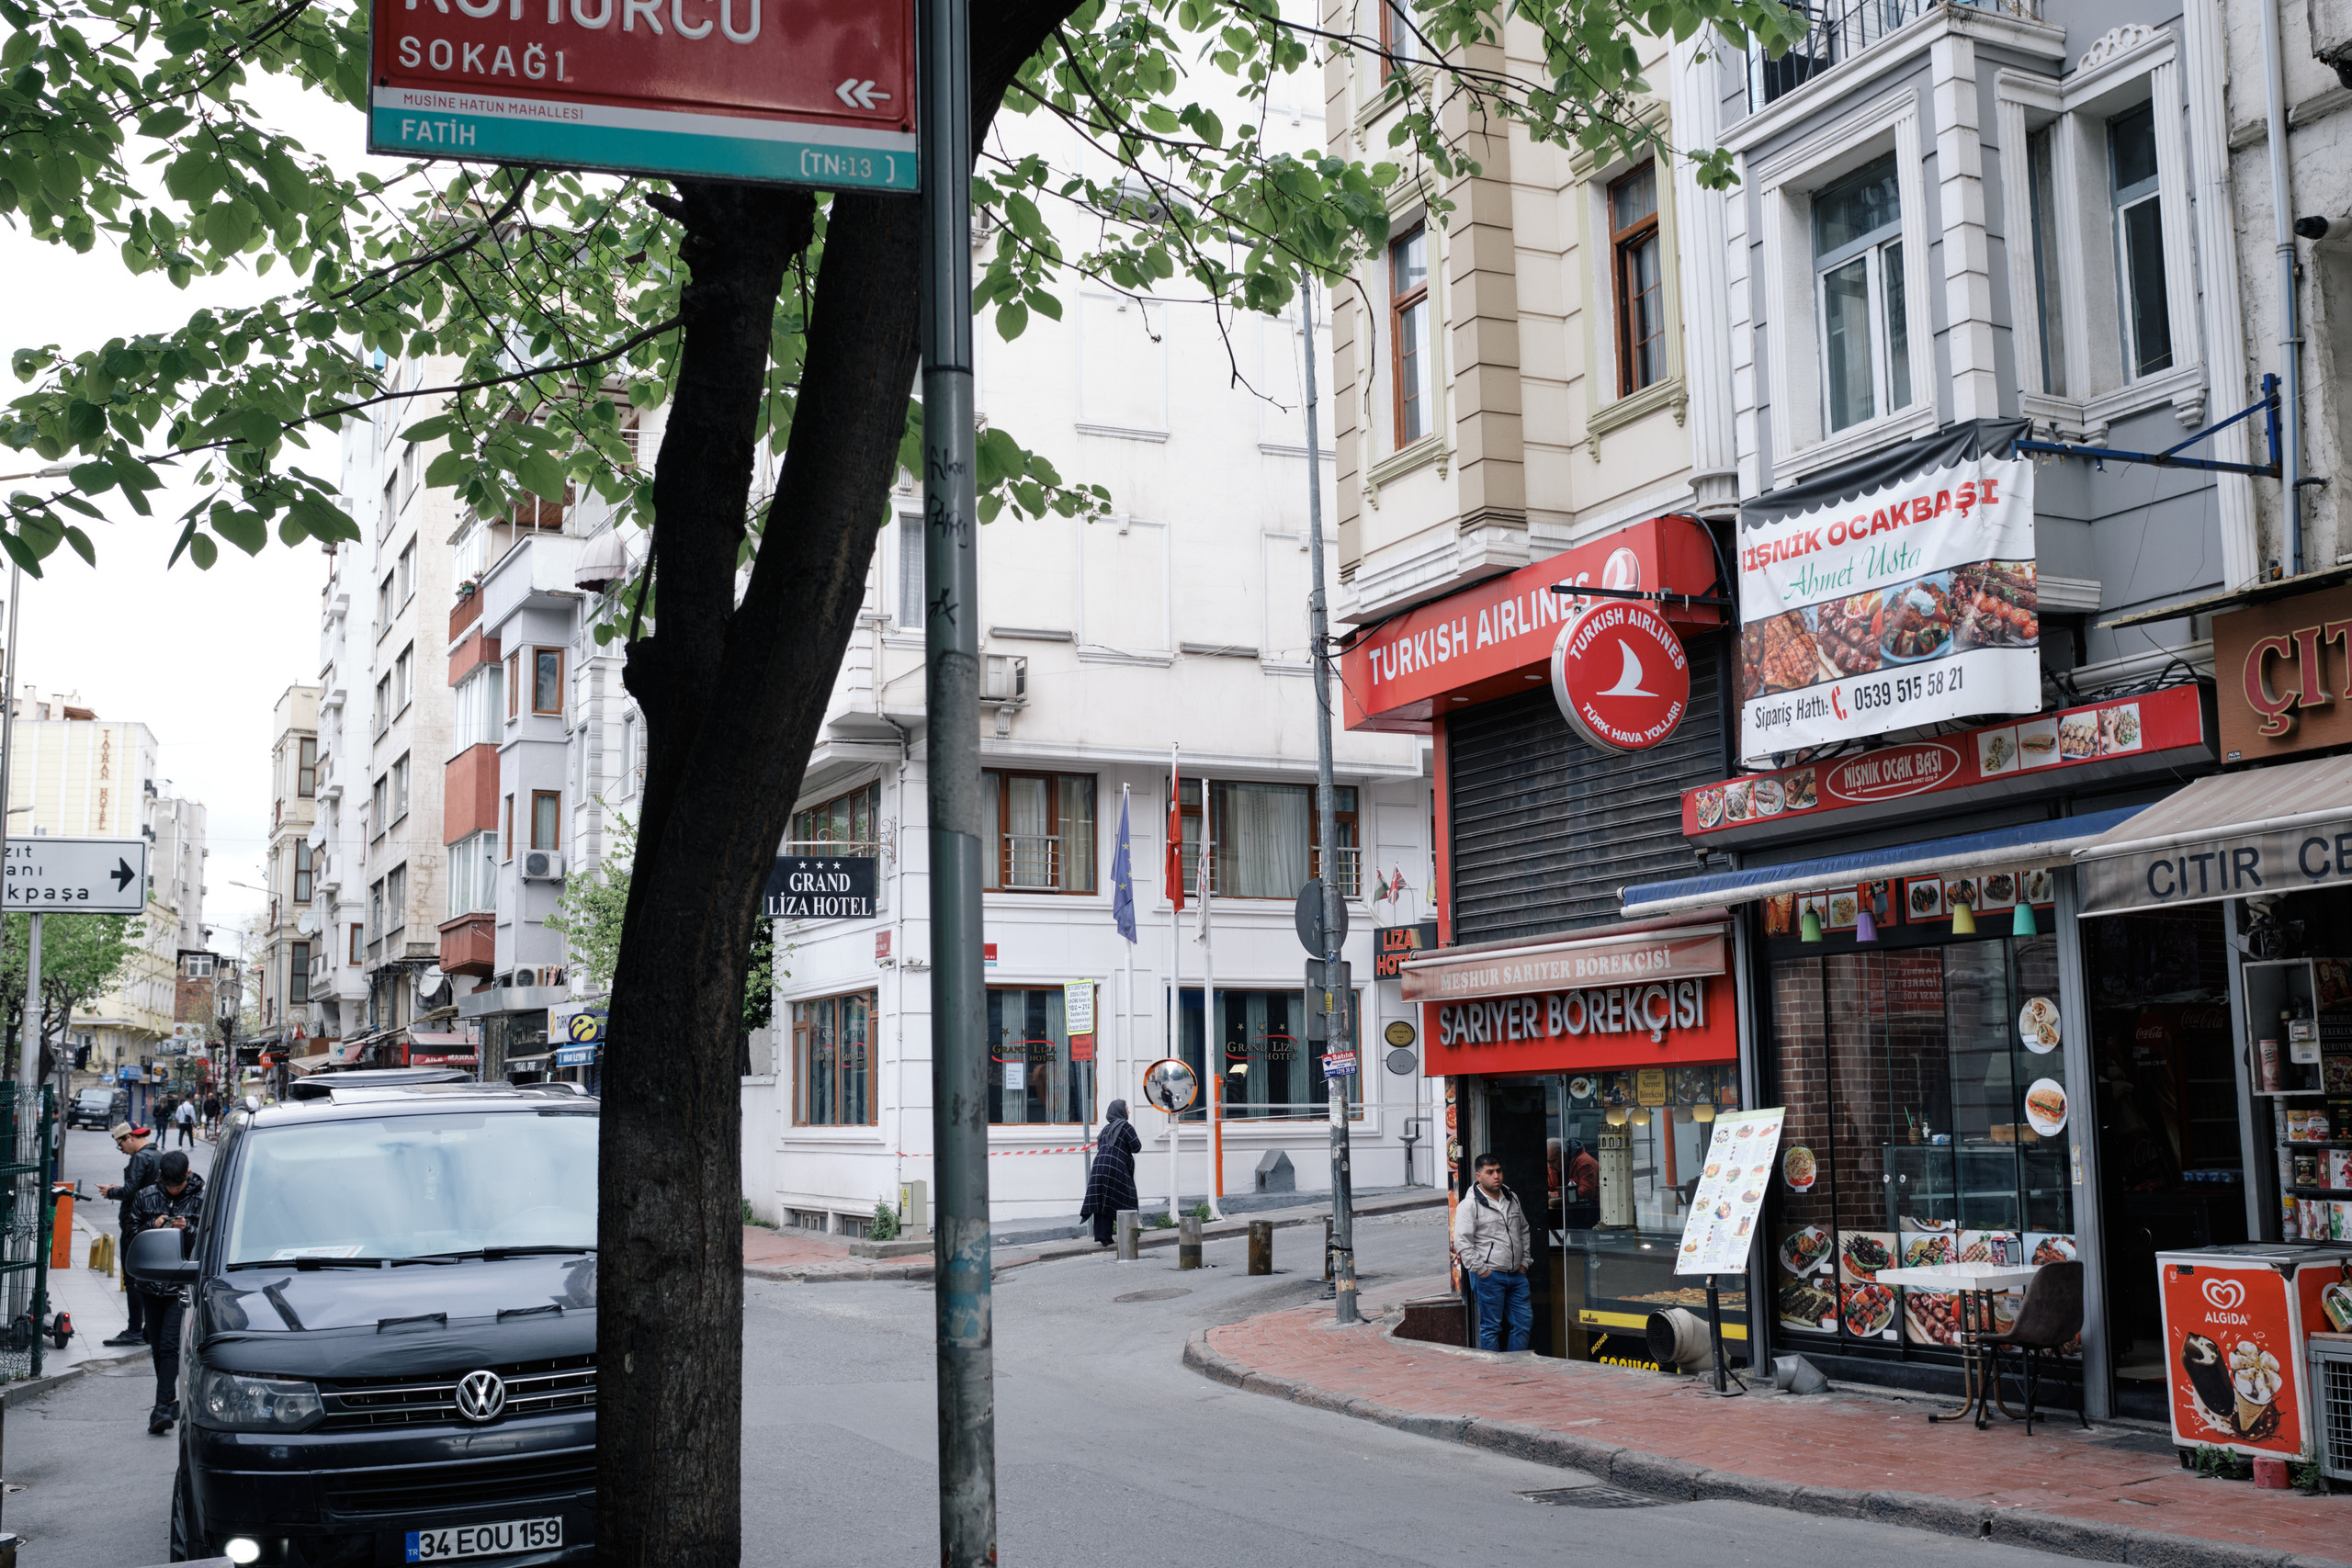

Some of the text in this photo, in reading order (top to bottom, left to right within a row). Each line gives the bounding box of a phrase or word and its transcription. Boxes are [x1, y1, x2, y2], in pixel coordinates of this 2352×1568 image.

[399, 35, 564, 82] SOKAĞI
[403, 94, 583, 120] MUSİNE HATUN MAHALLESİ
[401, 118, 476, 146] FATİH
[1827, 479, 1999, 547] OCAKBAŞI
[1783, 541, 1922, 601] Ahmet Usta
[1368, 570, 1592, 686] TURKISH AIRLINES
[1569, 607, 1685, 671] TURKISH AIRLINES
[1755, 701, 1792, 731] Sipariş
[1854, 682, 1892, 711] 0539
[1896, 675, 1922, 703] 515
[1928, 671, 1944, 696] 58
[1949, 665, 1963, 691] 21
[1582, 701, 1682, 742] TÜRK HAVA YOLLARI
[1883, 754, 1914, 782] OCAK
[98, 787, 108, 830] HOTEL
[789, 872, 852, 892] GRAND
[768, 891, 872, 916] LİZA HOTEL
[1376, 953, 1411, 976] HOT
[1440, 944, 1671, 993] MEŞHUR SARIYER BÖREKÇİSİ
[1439, 977, 1704, 1047] SARIYER BÖREKÇİSİ
[992, 1043, 1027, 1054] GRAND
[1227, 1042, 1267, 1052] GRAND
[1264, 1053, 1297, 1061] HOTEL
[1332, 1052, 1354, 1060] Satılık
[408, 1549, 418, 1557] TR
[420, 1519, 560, 1558] 34 EOU 159
